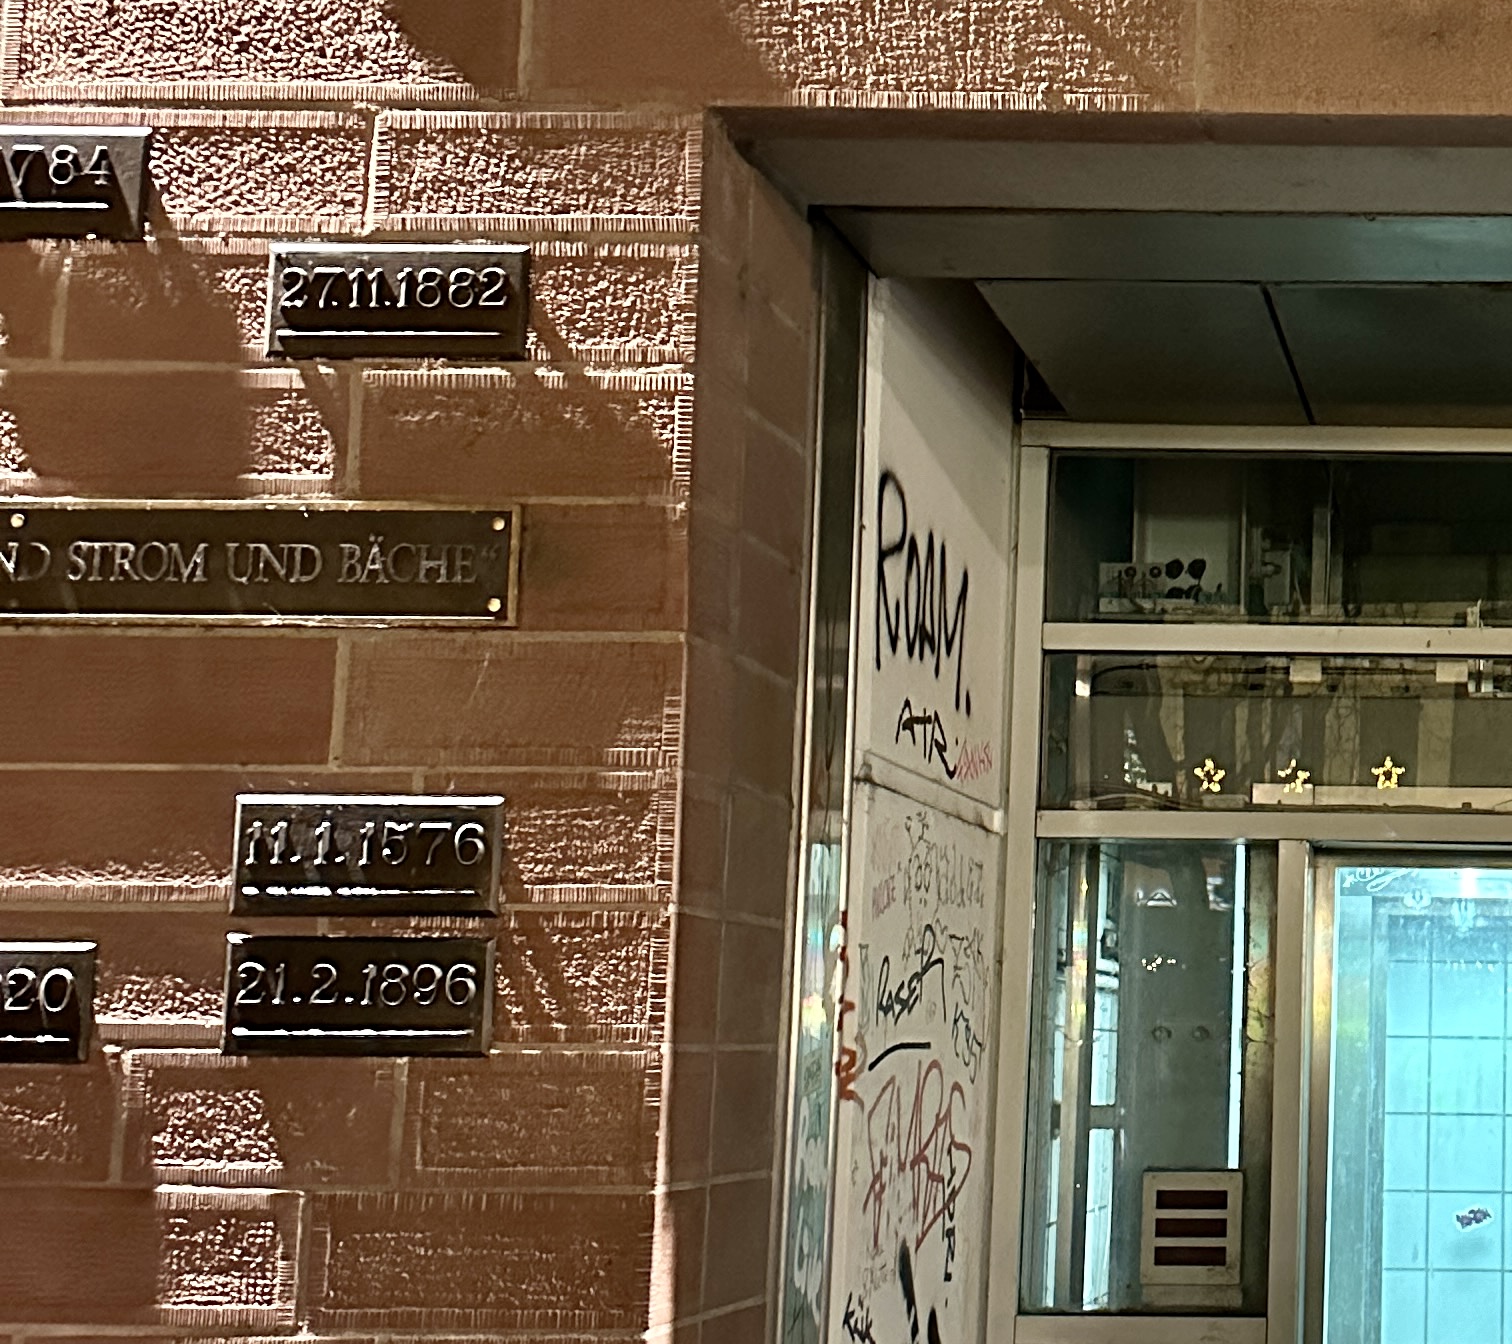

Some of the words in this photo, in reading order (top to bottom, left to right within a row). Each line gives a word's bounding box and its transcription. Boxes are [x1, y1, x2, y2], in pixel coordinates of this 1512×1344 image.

[0, 143, 111, 187] 784
[279, 266, 508, 309] 27.11.1882
[66, 540, 209, 582] STROM
[226, 542, 323, 584] UND
[244, 819, 486, 866] 11.1.1576
[0, 967, 75, 1013] 20
[234, 961, 478, 1006] 21.2.1896
